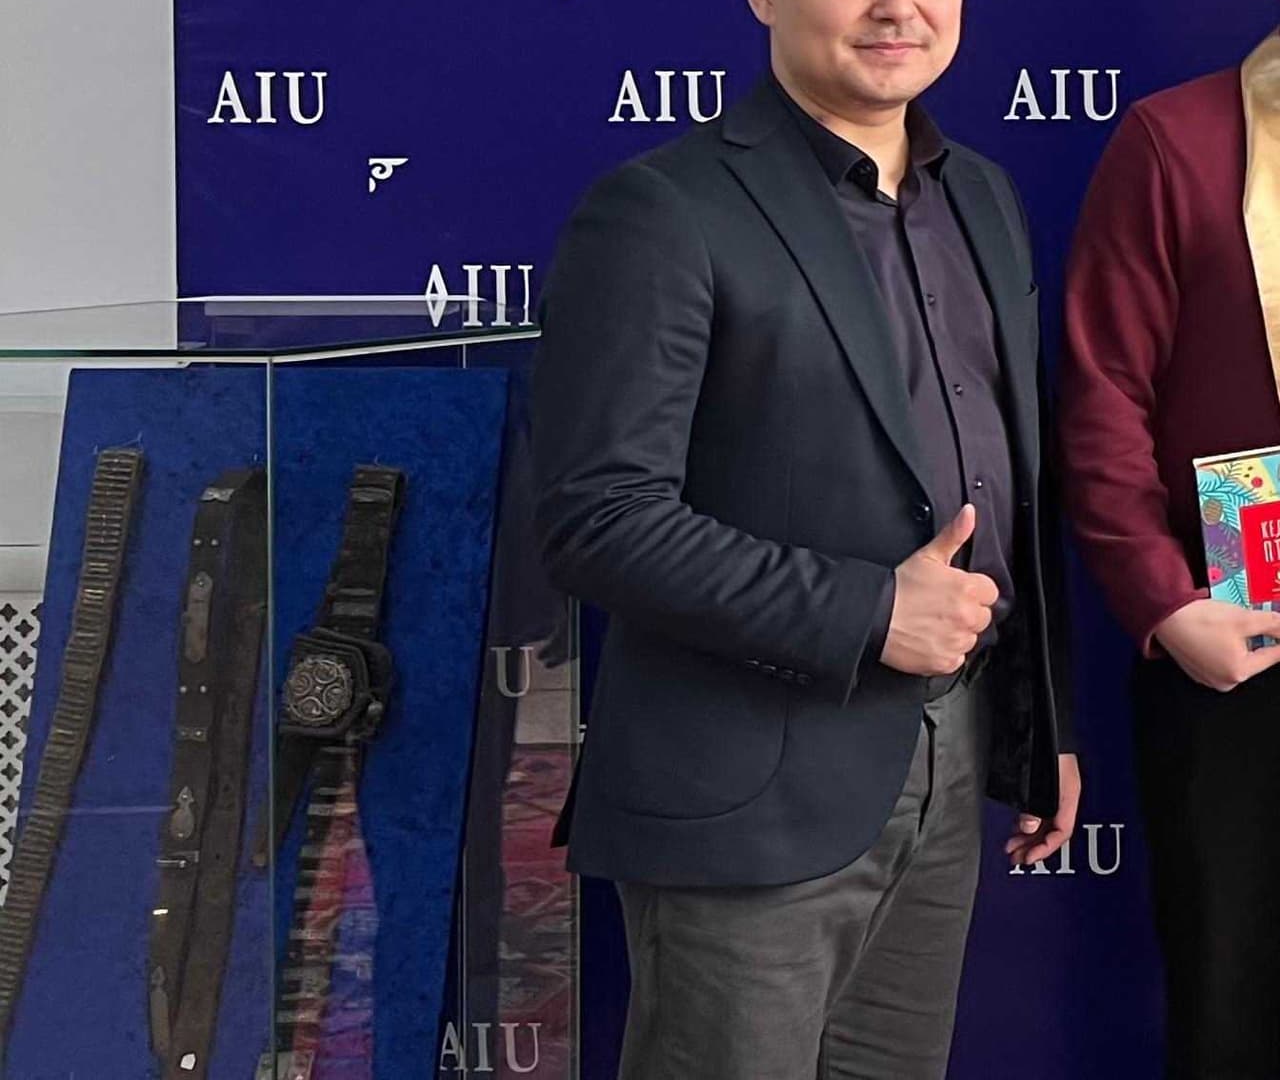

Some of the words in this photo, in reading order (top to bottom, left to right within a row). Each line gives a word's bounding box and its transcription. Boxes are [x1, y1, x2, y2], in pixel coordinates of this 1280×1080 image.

[207, 70, 328, 125] AIU
[607, 70, 726, 123] AIU
[1003, 68, 1121, 121] AIU
